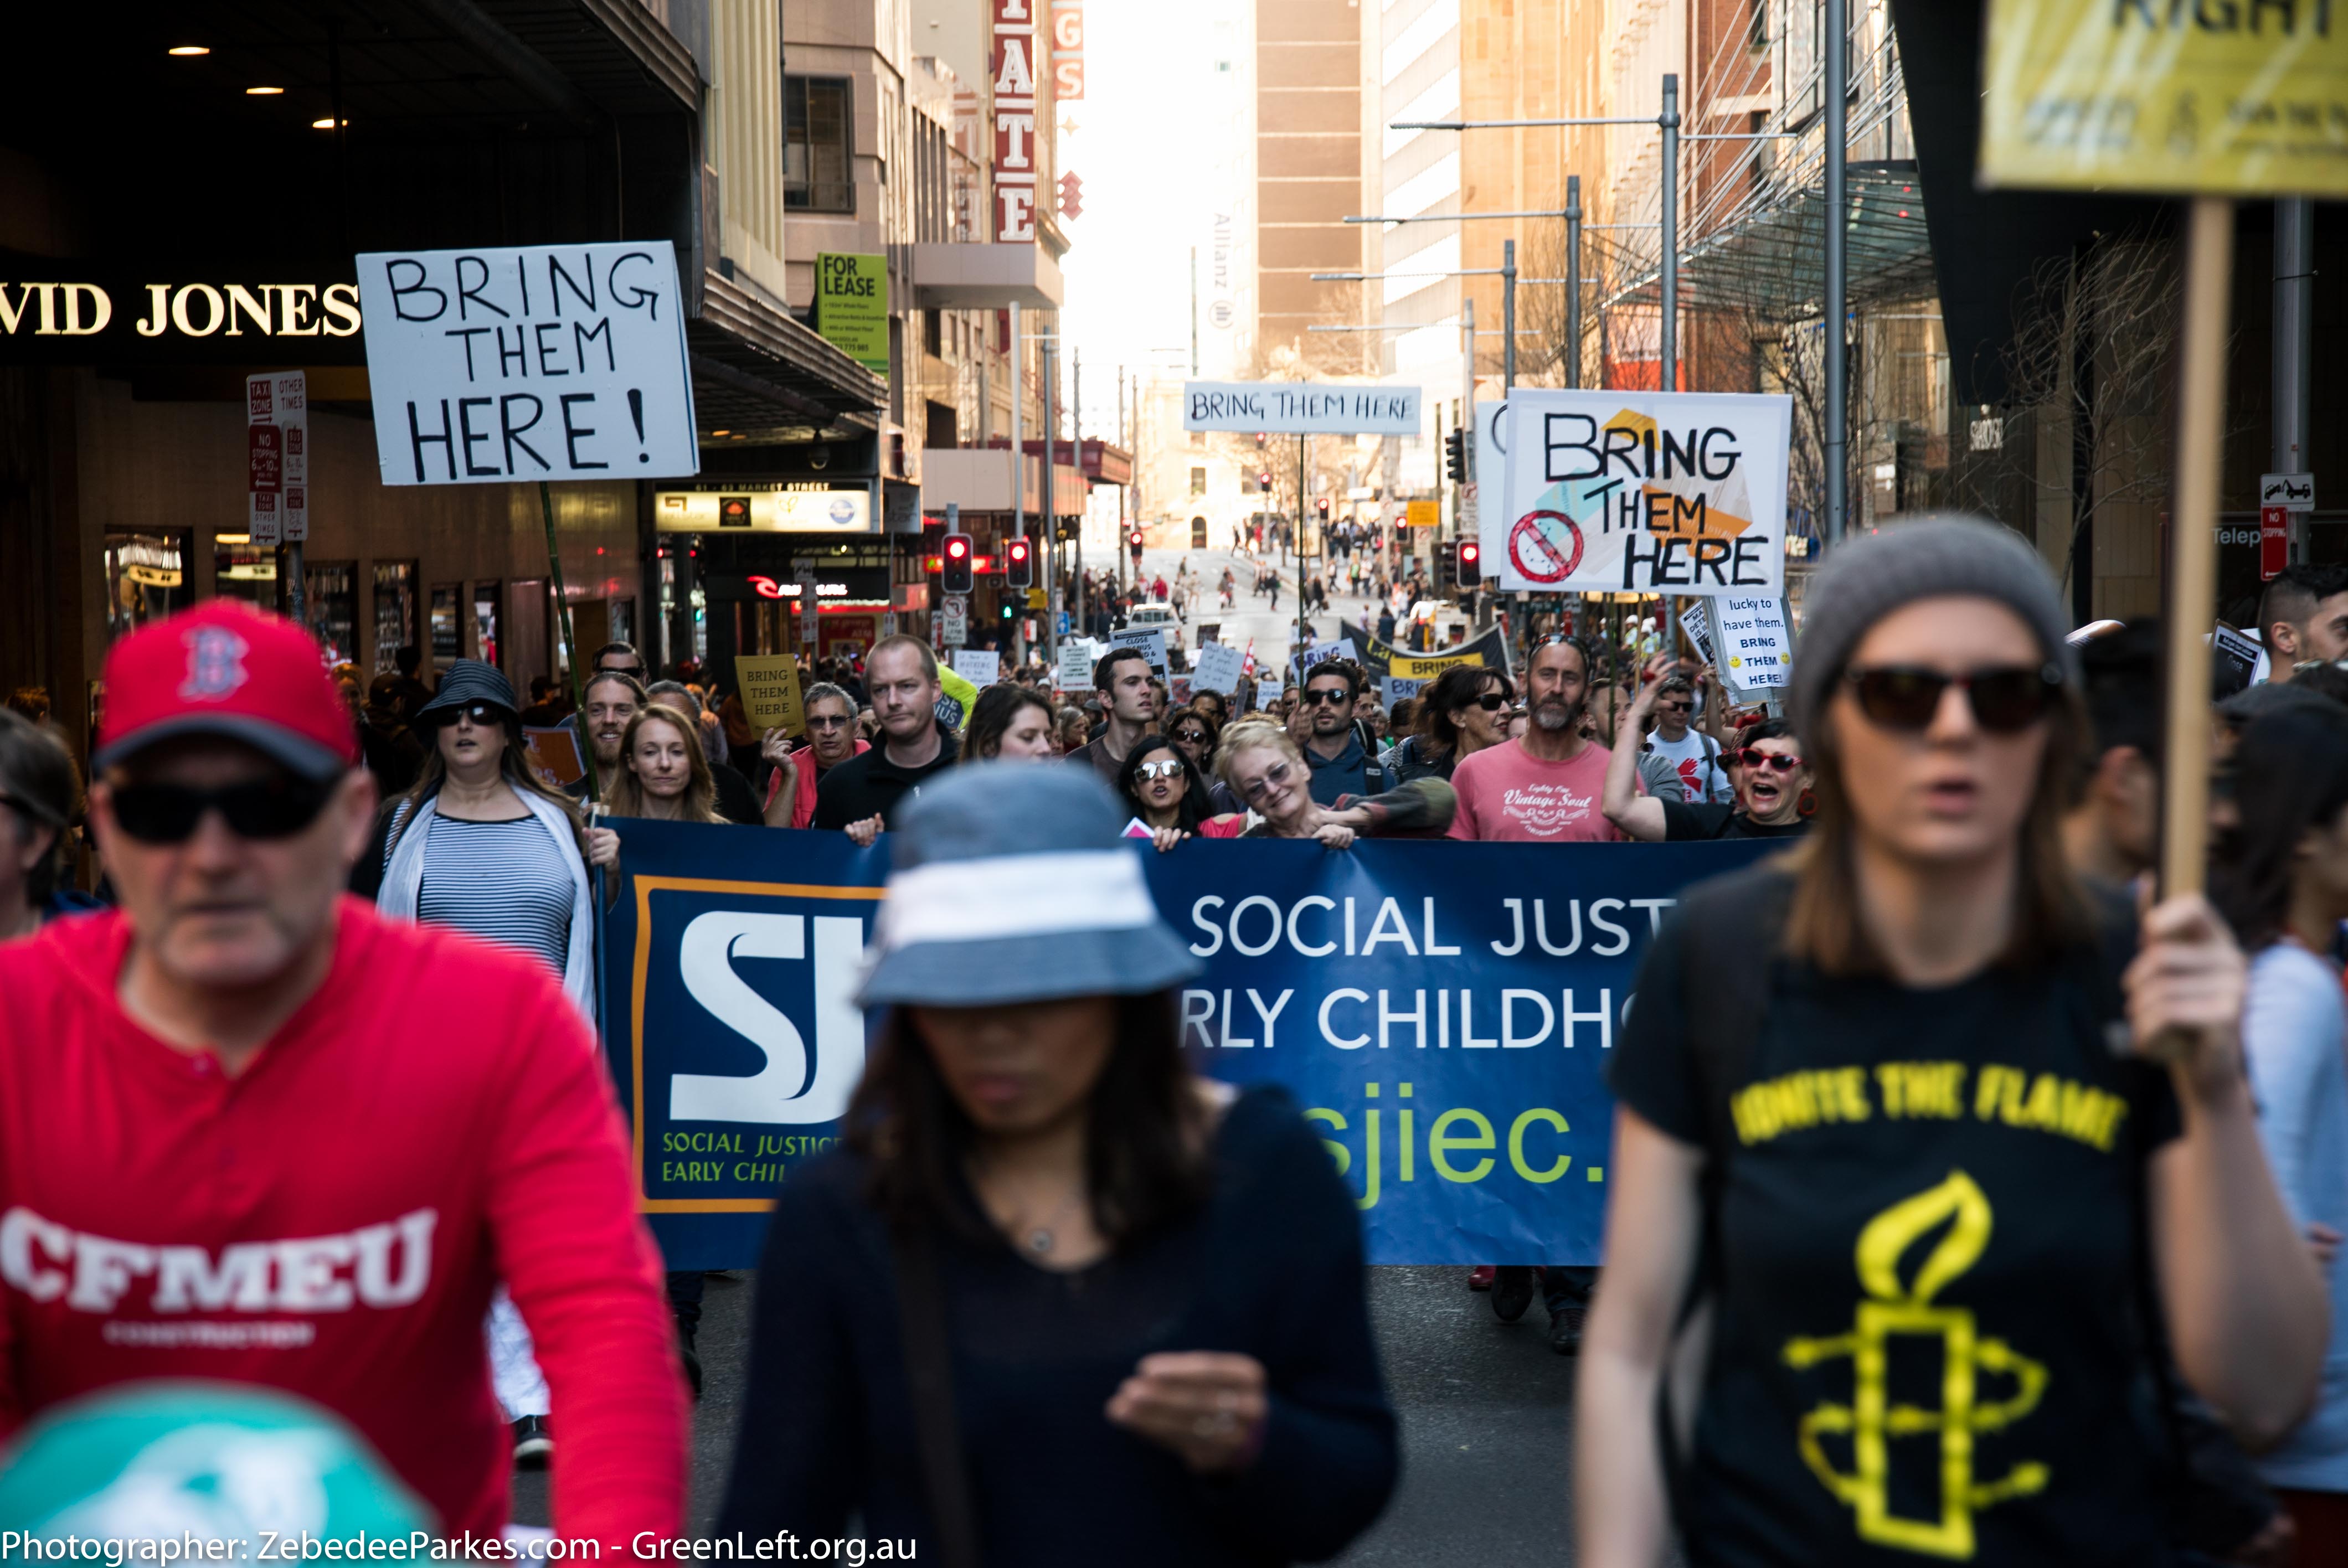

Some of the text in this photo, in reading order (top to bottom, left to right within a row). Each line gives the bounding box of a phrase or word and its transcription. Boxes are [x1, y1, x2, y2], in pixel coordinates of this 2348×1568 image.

[1214, 213, 1230, 288] Allianz
[823, 256, 857, 275] FOR
[386, 252, 659, 322] BRING
[825, 276, 876, 297] LEASE
[0, 282, 361, 337] VID JONES
[445, 317, 615, 381] THEM
[251, 383, 271, 397] TAXI
[279, 378, 303, 393] OTHER
[251, 399, 272, 414] ZONE
[281, 396, 303, 411] TIMES
[1192, 390, 1415, 421] BRING THEM HERE
[259, 434, 271, 446] NO
[407, 389, 650, 482] HERE!
[253, 449, 277, 459] STOPPING
[1544, 412, 1742, 482] BRING
[738, 483, 781, 492] MARKET
[786, 482, 830, 492] STREET
[1583, 477, 1706, 534] THEM
[2269, 513, 2279, 522] NO
[2263, 527, 2286, 538] STOPPING
[1623, 534, 1769, 589] HERE
[1729, 599, 1772, 611] lucky to
[1723, 617, 1784, 631] have them.
[1740, 637, 1775, 648] BRING
[176, 622, 250, 703] B
[1745, 657, 1778, 667] THEM
[747, 670, 788, 682] BRING
[1749, 674, 1783, 685] HERE!
[750, 687, 789, 698] THEM
[755, 703, 790, 715] HERE
[1503, 788, 1593, 808] Vintage Soul
[1188, 895, 1462, 957] SOCIAL
[1730, 1060, 2130, 1153] IGNITE THE FLAME
[663, 1132, 744, 1153] SOCIAL
[663, 1161, 724, 1182] EARLY
[0, 1205, 439, 1314] CFMEU
